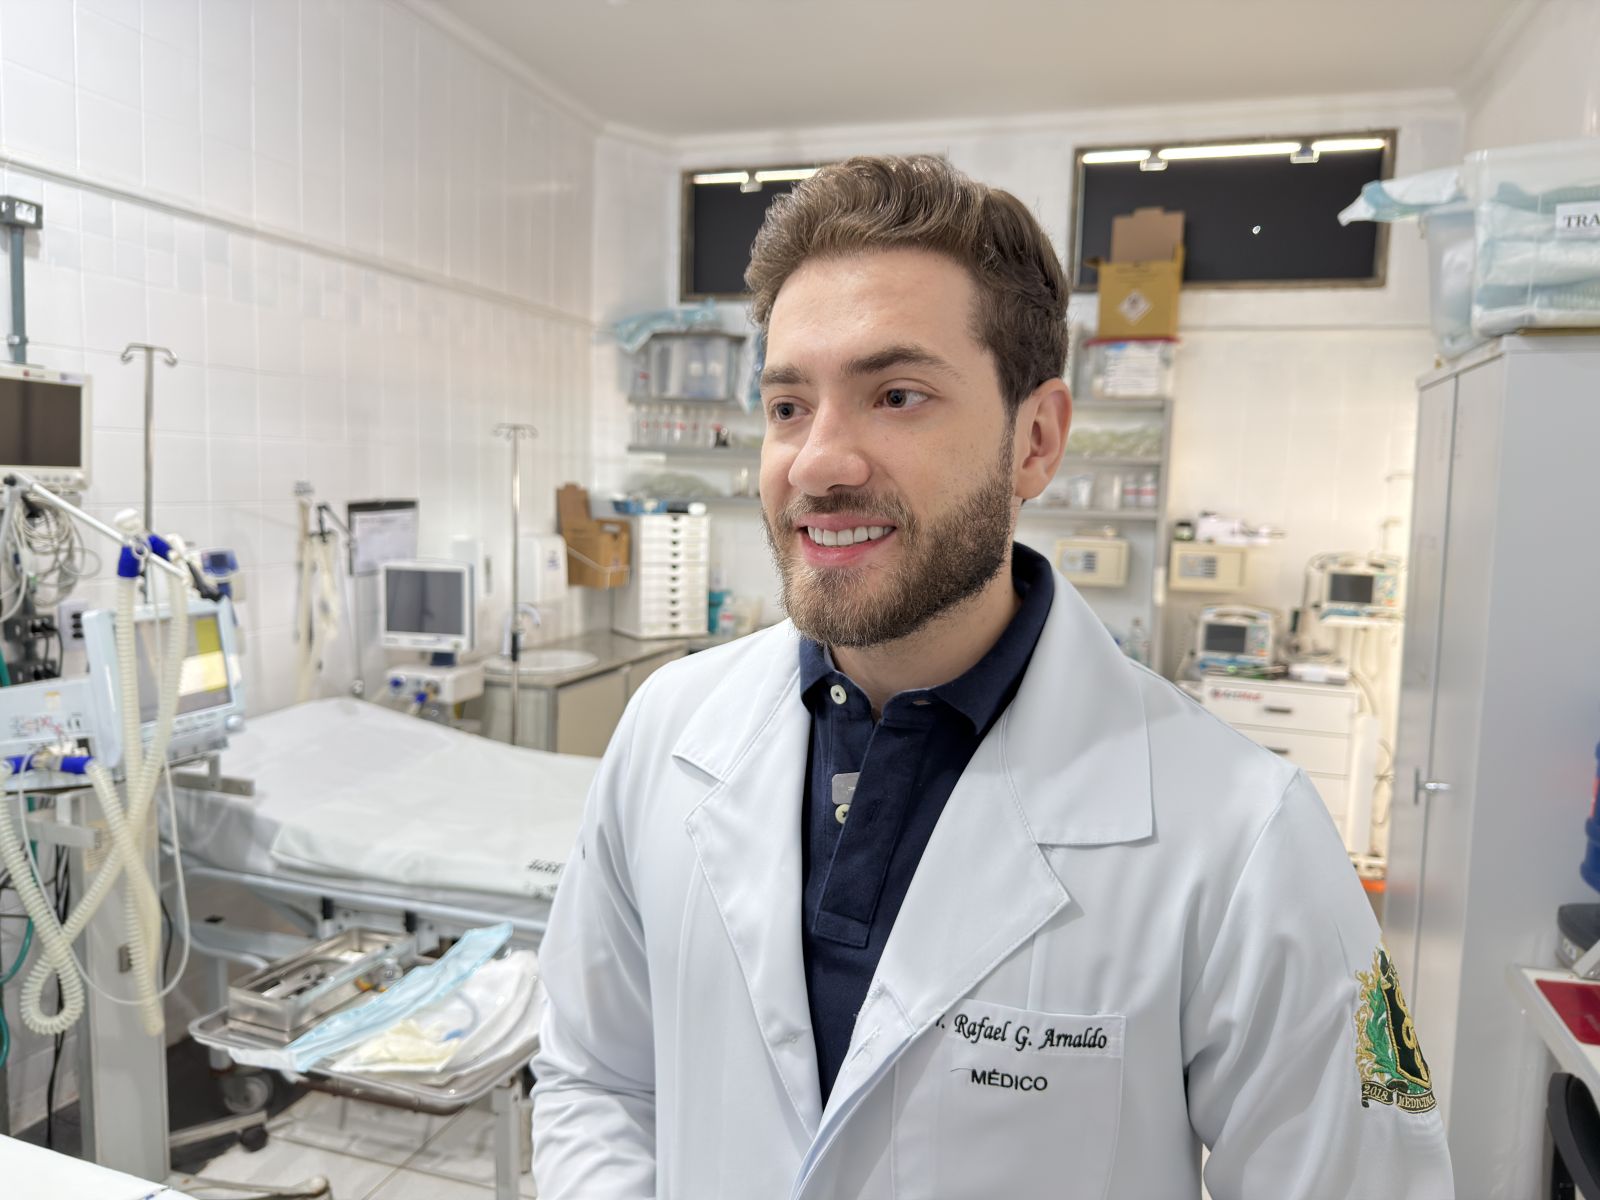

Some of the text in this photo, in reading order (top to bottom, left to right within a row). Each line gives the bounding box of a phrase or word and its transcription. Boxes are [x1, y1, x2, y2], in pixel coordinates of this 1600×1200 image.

[954, 1013, 1012, 1044] Rafael
[1014, 1025, 1032, 1051] G.
[1037, 1027, 1108, 1050] Arnaldo
[971, 1068, 1048, 1091] MÉDICO
[1363, 1083, 1389, 1101] 2018
